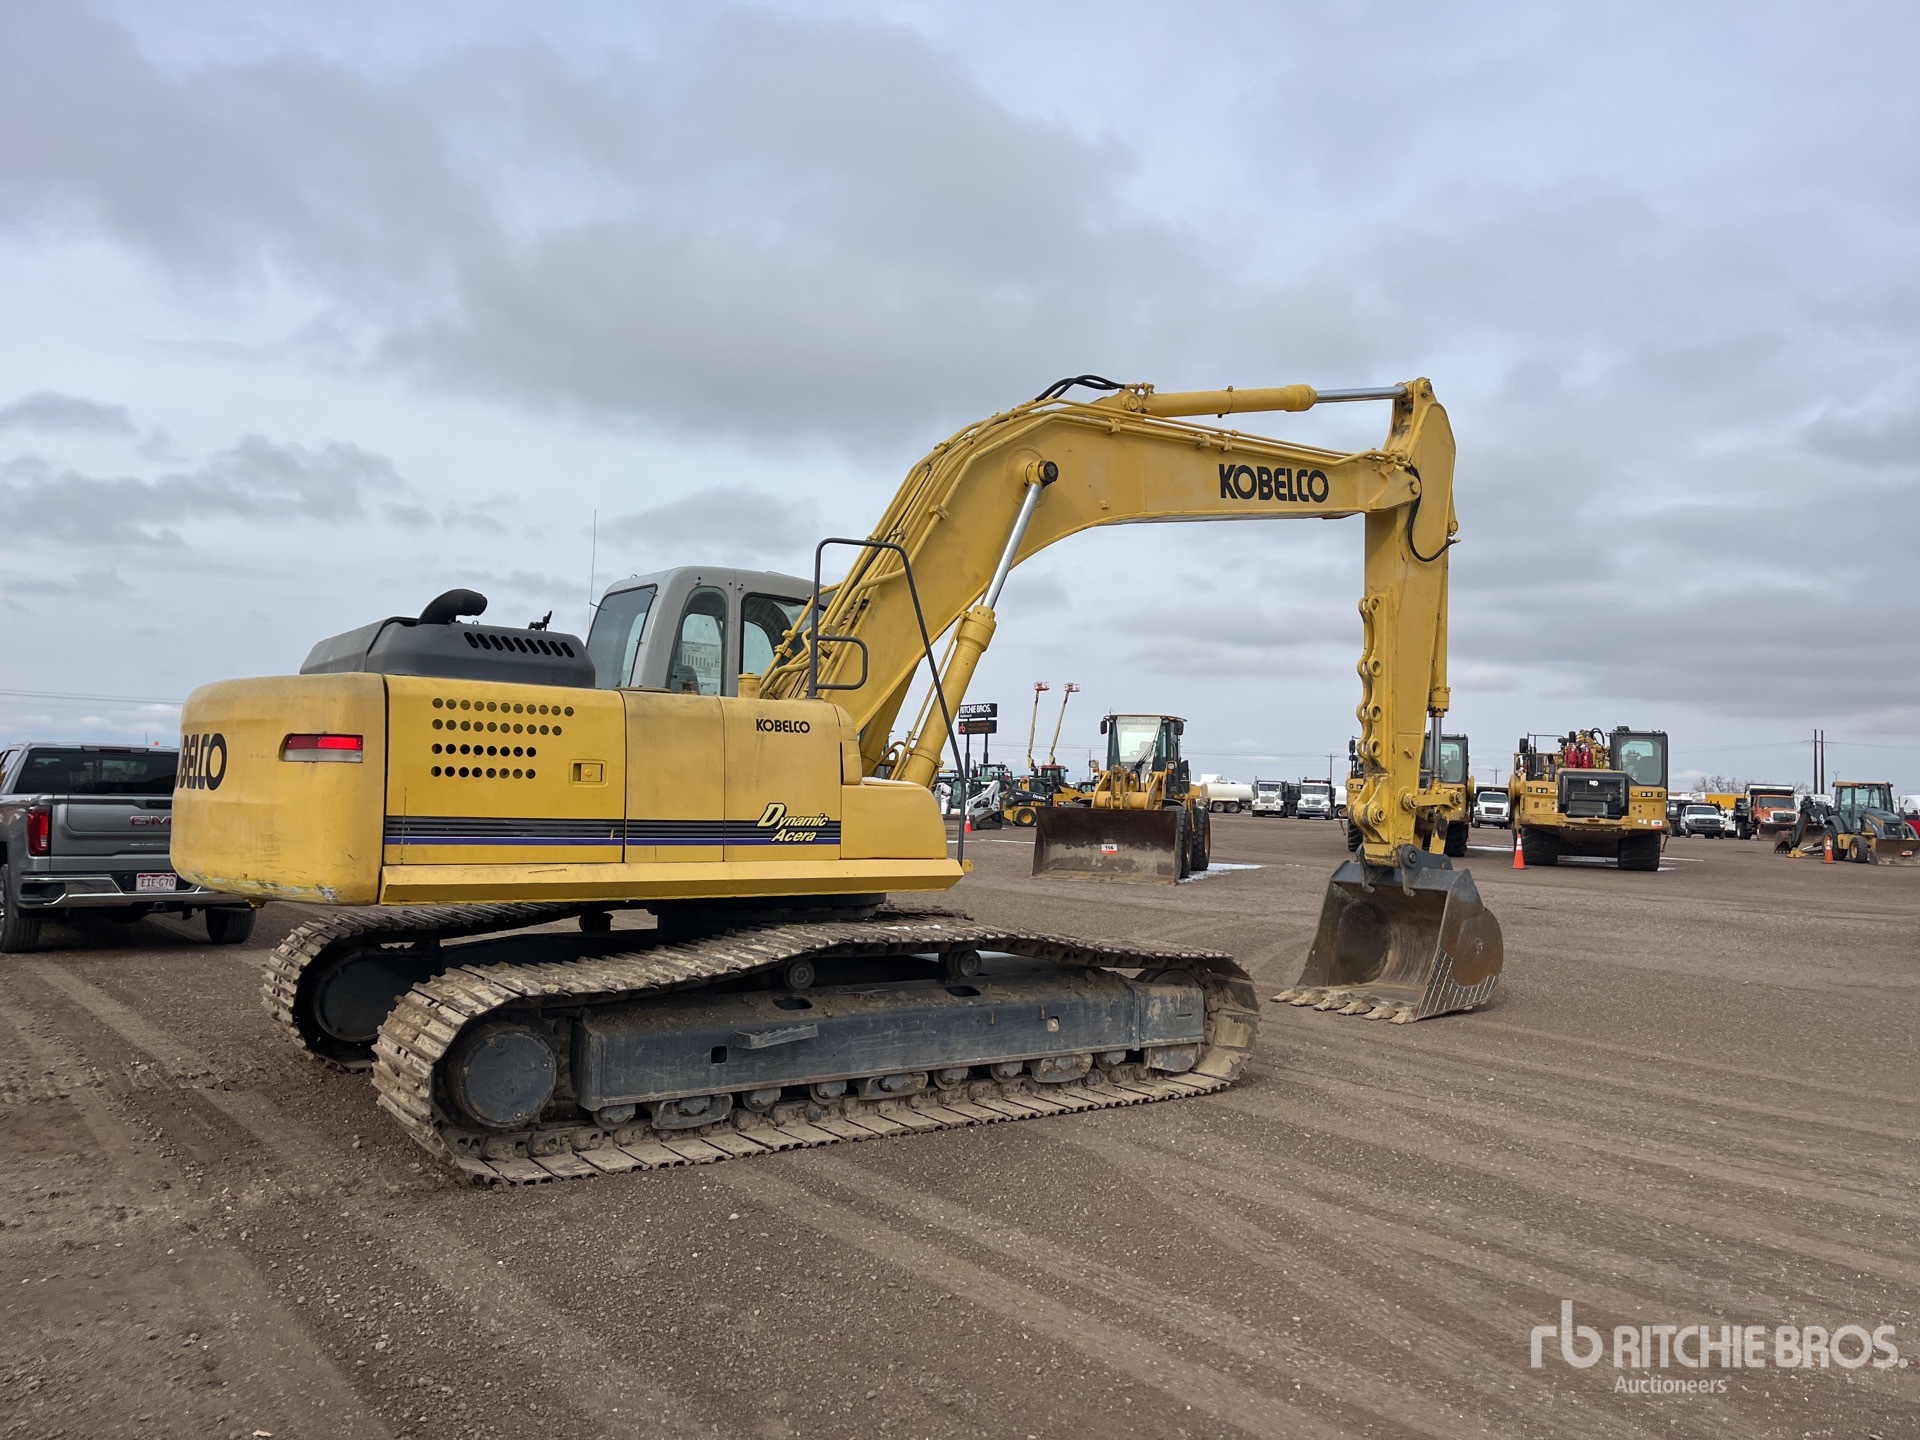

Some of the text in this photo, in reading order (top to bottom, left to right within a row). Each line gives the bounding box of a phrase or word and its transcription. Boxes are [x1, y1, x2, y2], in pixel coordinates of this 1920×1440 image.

[1218, 463, 1329, 503] KOBELCO
[756, 719, 810, 733] KOBELCO
[175, 732, 227, 791] BELCO
[130, 815, 173, 826] GM
[757, 802, 830, 830] Dynamic
[770, 828, 817, 842] Acera
